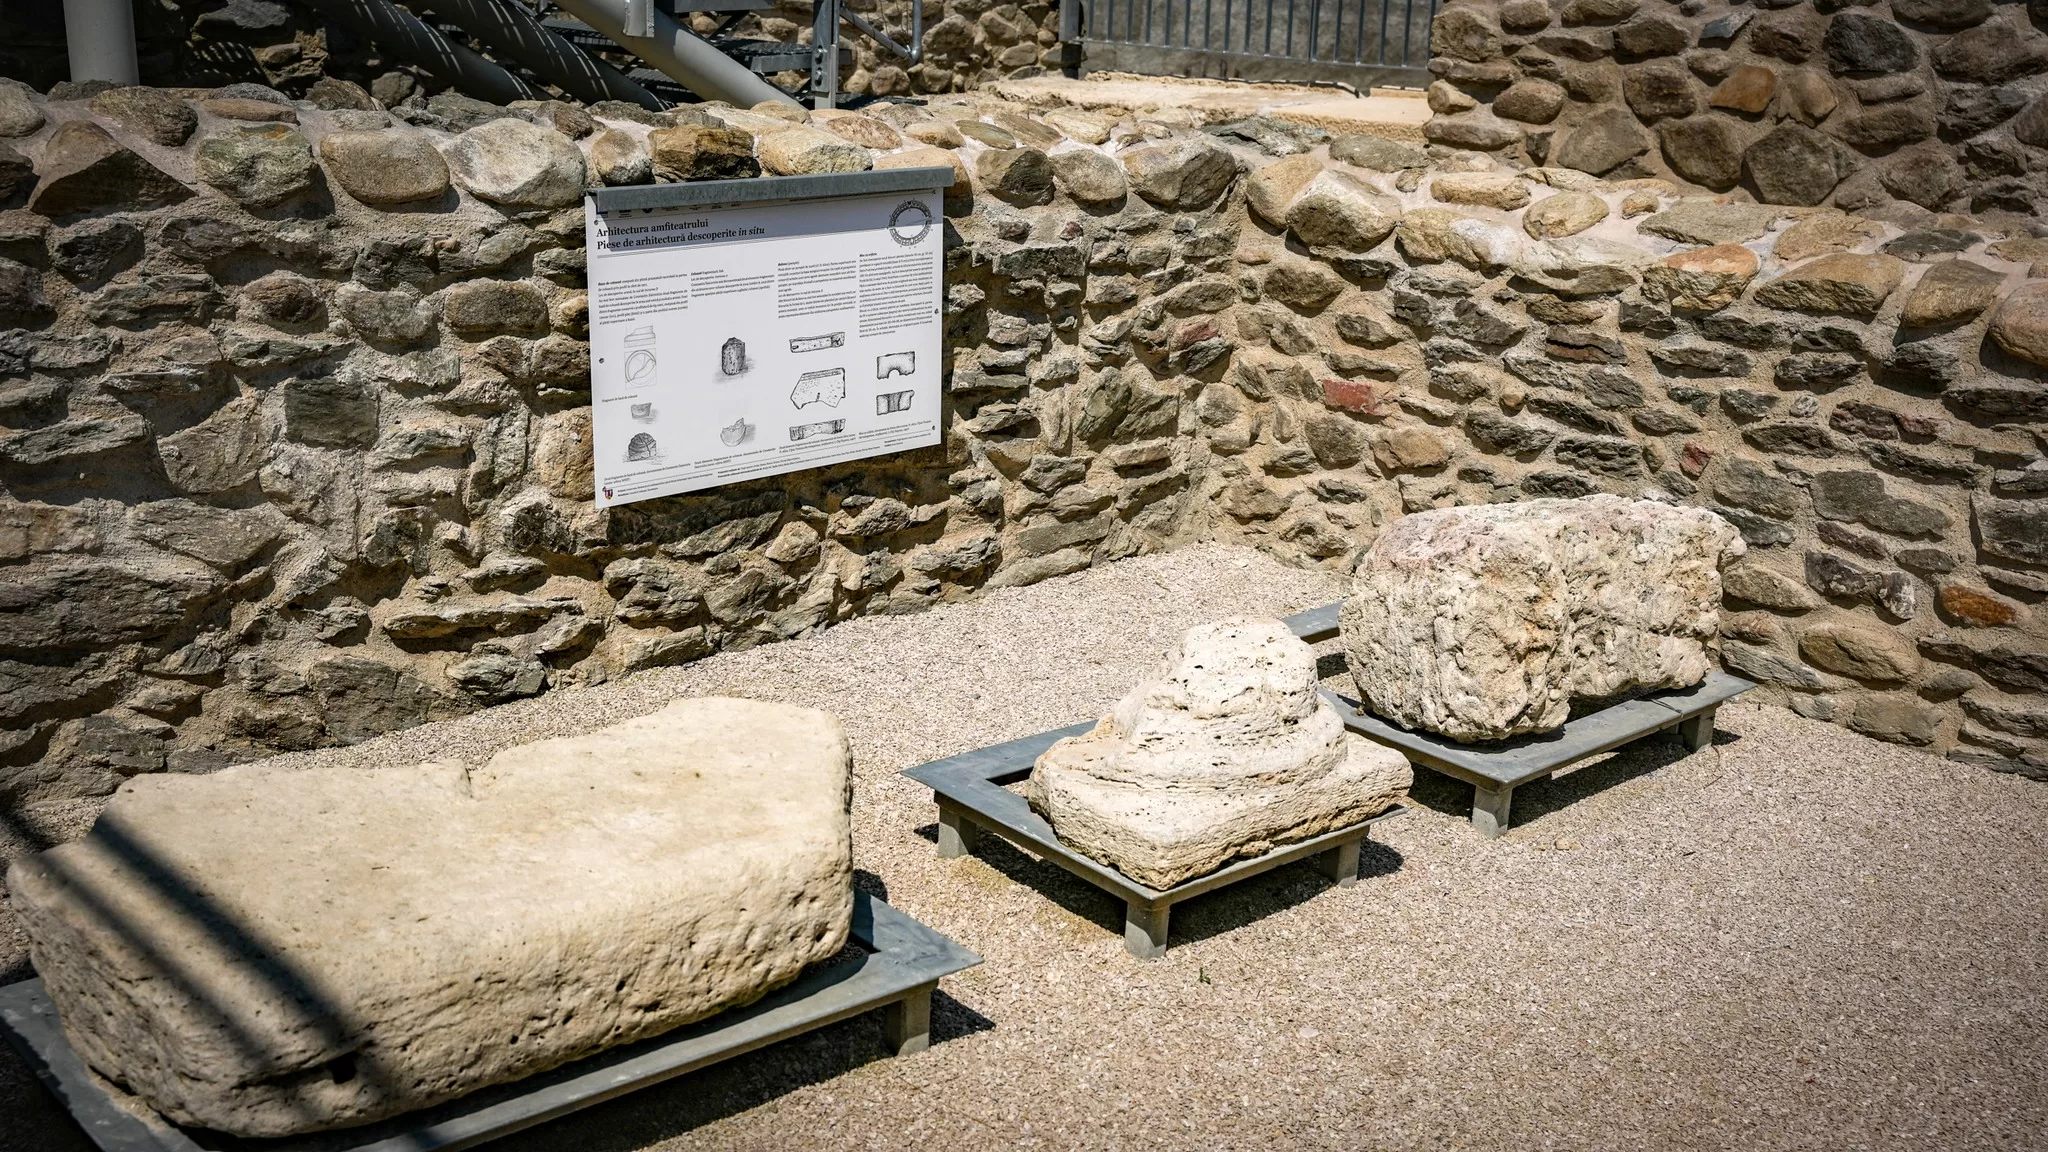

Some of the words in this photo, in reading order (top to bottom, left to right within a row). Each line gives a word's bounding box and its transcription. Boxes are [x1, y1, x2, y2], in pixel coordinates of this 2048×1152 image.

[596, 226, 649, 237] Arhitectura
[651, 218, 709, 231] amfiteatrului
[597, 240, 620, 250] Piese
[623, 238, 634, 247] de
[636, 233, 686, 245] arhitectură
[687, 229, 737, 241] descoperite
[738, 227, 747, 236] in
[748, 226, 765, 236] situ
